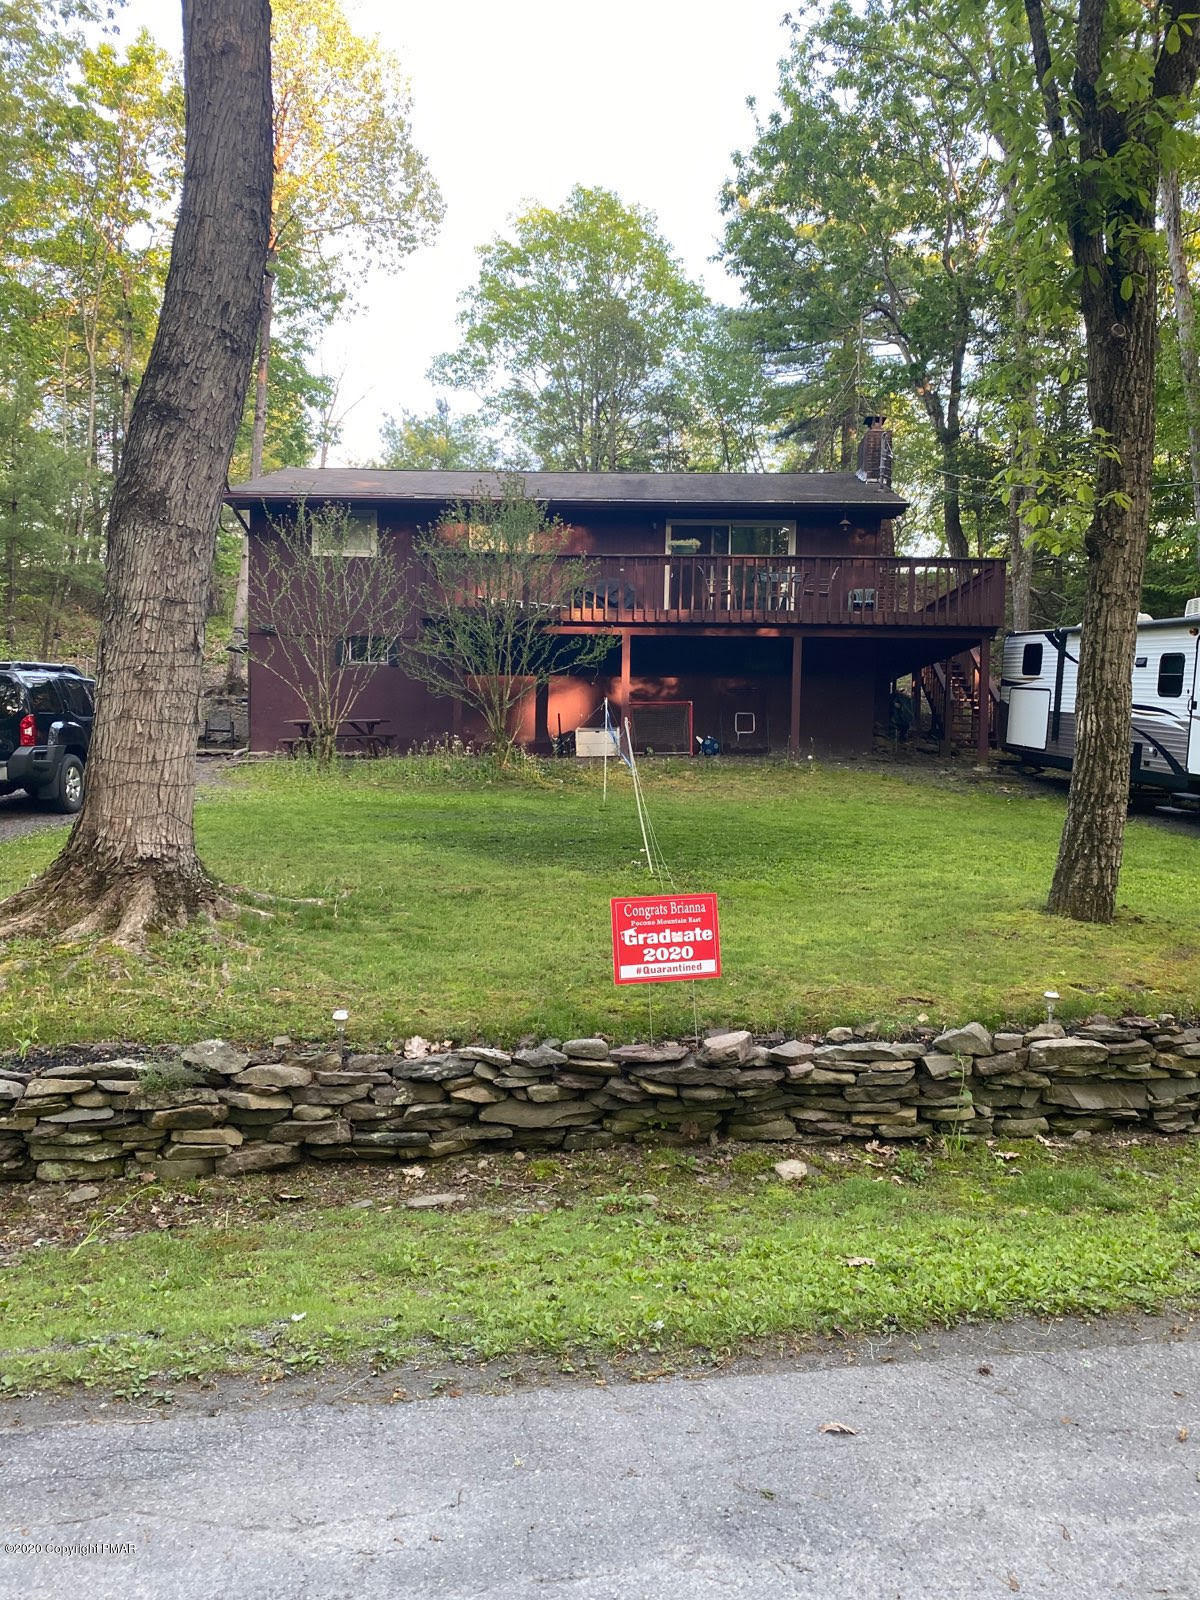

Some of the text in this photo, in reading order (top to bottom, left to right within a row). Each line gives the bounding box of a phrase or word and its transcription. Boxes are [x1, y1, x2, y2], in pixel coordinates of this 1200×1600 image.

[623, 901, 706, 920] Congrats Brianna
[656, 917, 687, 926] Mountain
[620, 927, 713, 946] Graduate
[642, 945, 694, 962] 2020
[636, 962, 703, 975] #Quarantined
